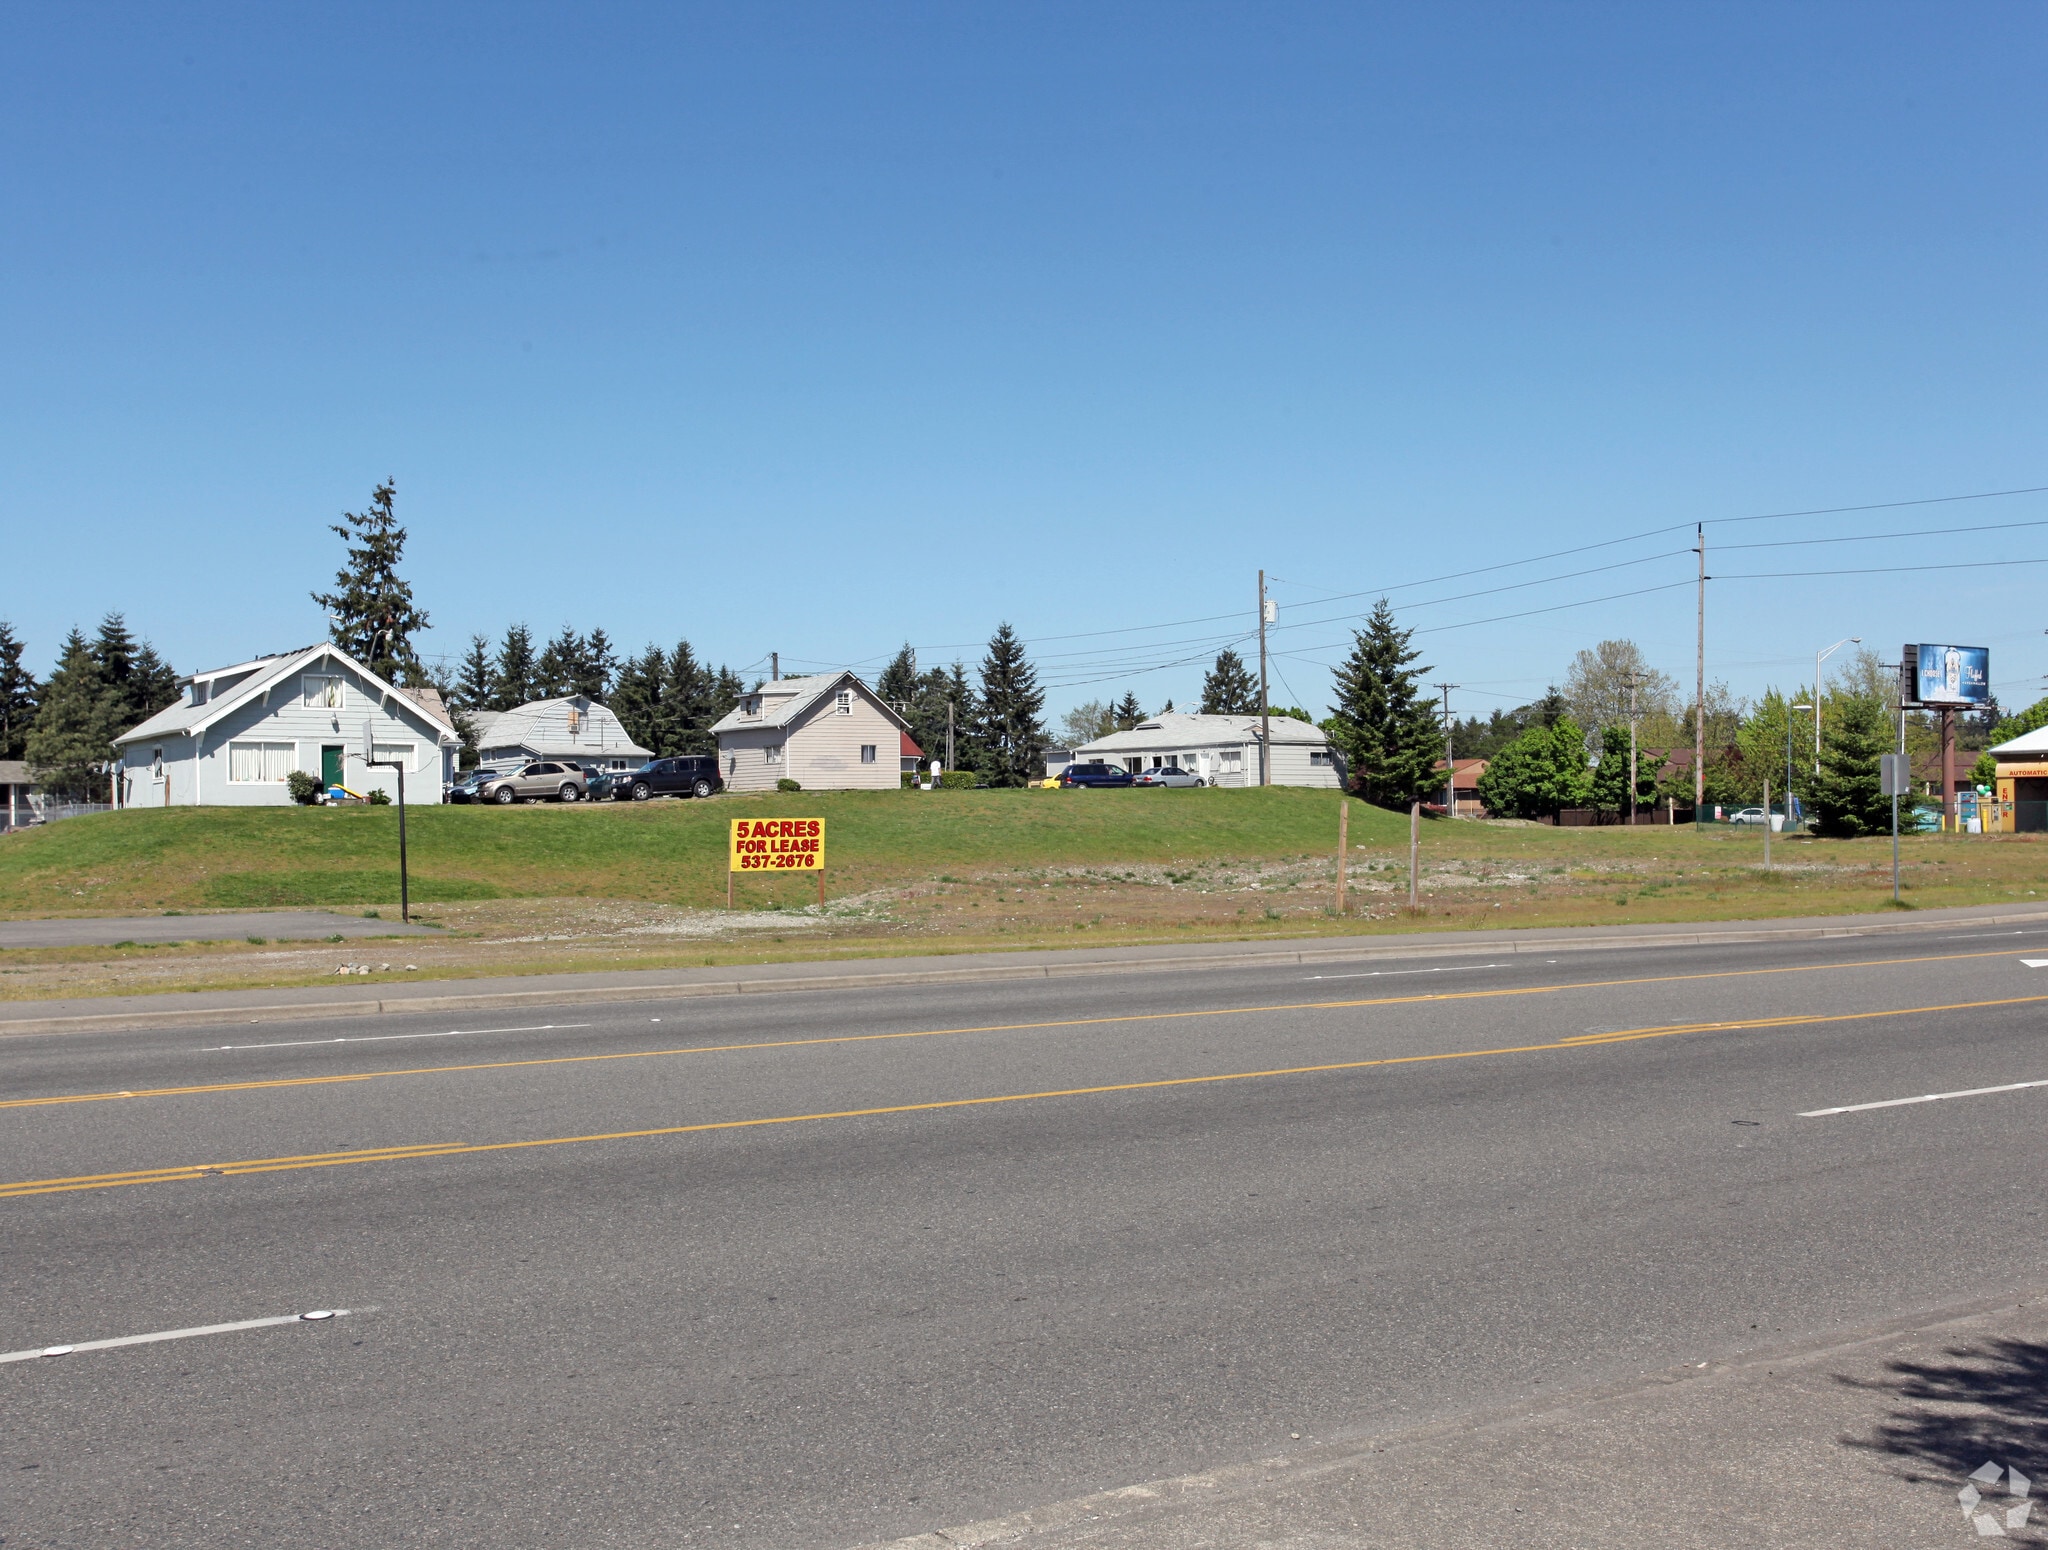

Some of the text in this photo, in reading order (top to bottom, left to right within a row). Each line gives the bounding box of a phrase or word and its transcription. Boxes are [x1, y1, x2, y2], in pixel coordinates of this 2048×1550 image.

[737, 821, 820, 838] 5 ACRES
[736, 839, 819, 853] FOR LEASE
[741, 854, 815, 868] 537-2676
